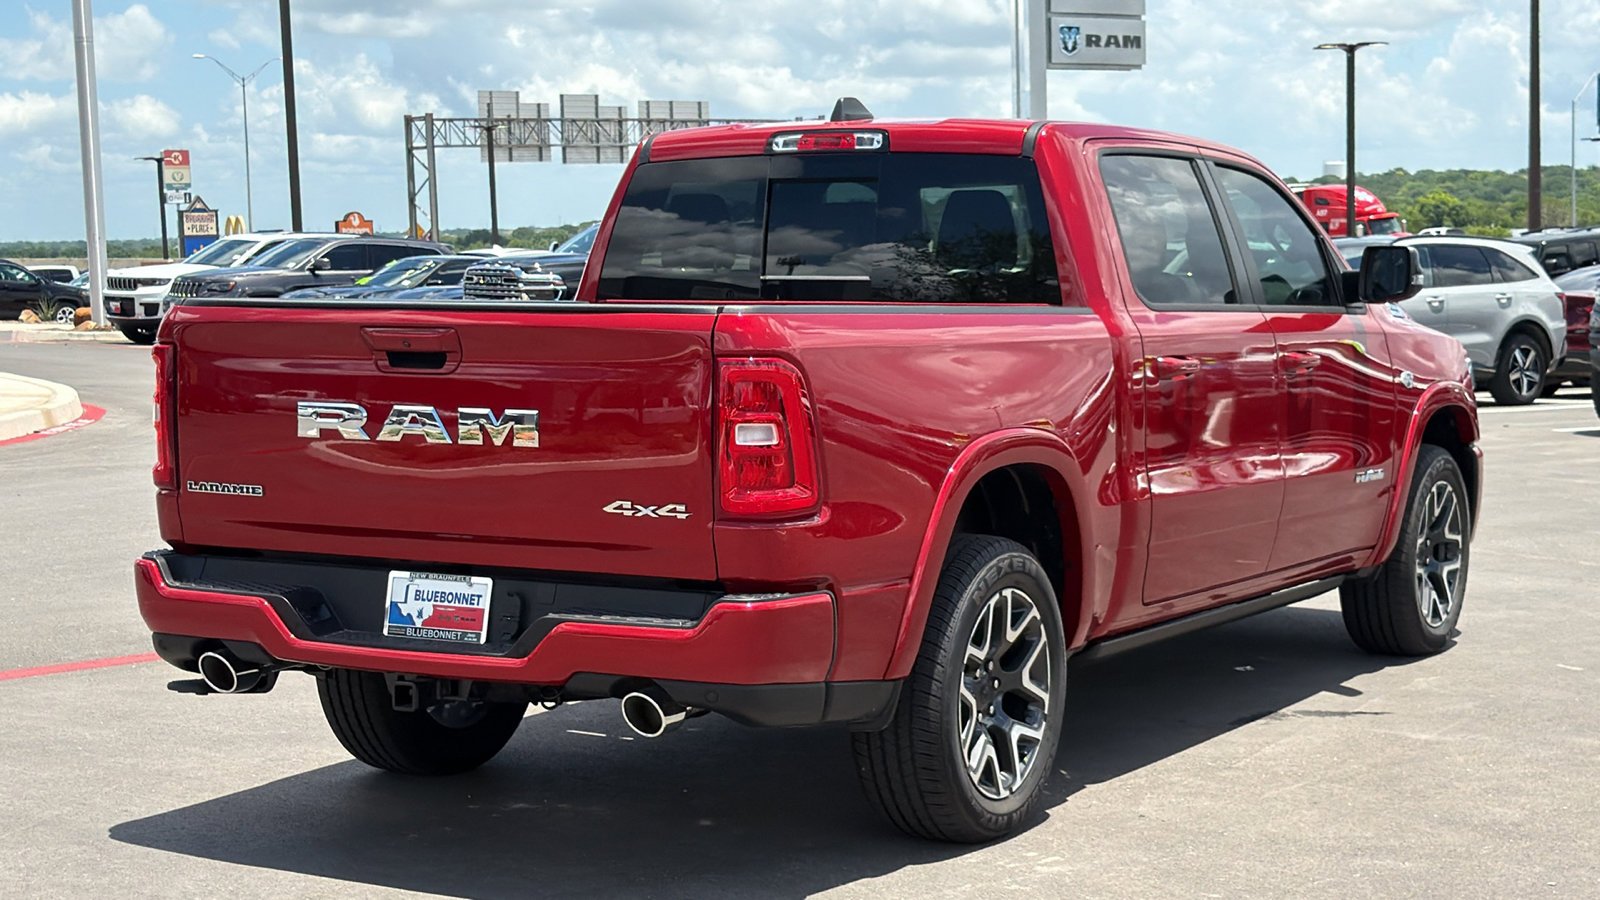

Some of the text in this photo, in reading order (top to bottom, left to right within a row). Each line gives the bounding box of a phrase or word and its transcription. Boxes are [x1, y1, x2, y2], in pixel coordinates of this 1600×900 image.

[1085, 34, 1142, 49] RAM
[191, 224, 209, 233] PLACE
[297, 402, 540, 448] RAM
[187, 481, 263, 497] LARAMIE
[602, 500, 693, 519] 4x4
[973, 557, 1038, 606] NEXEN
[414, 590, 483, 606] BLUEBONNET
[406, 627, 462, 640] BLUEBONNET
